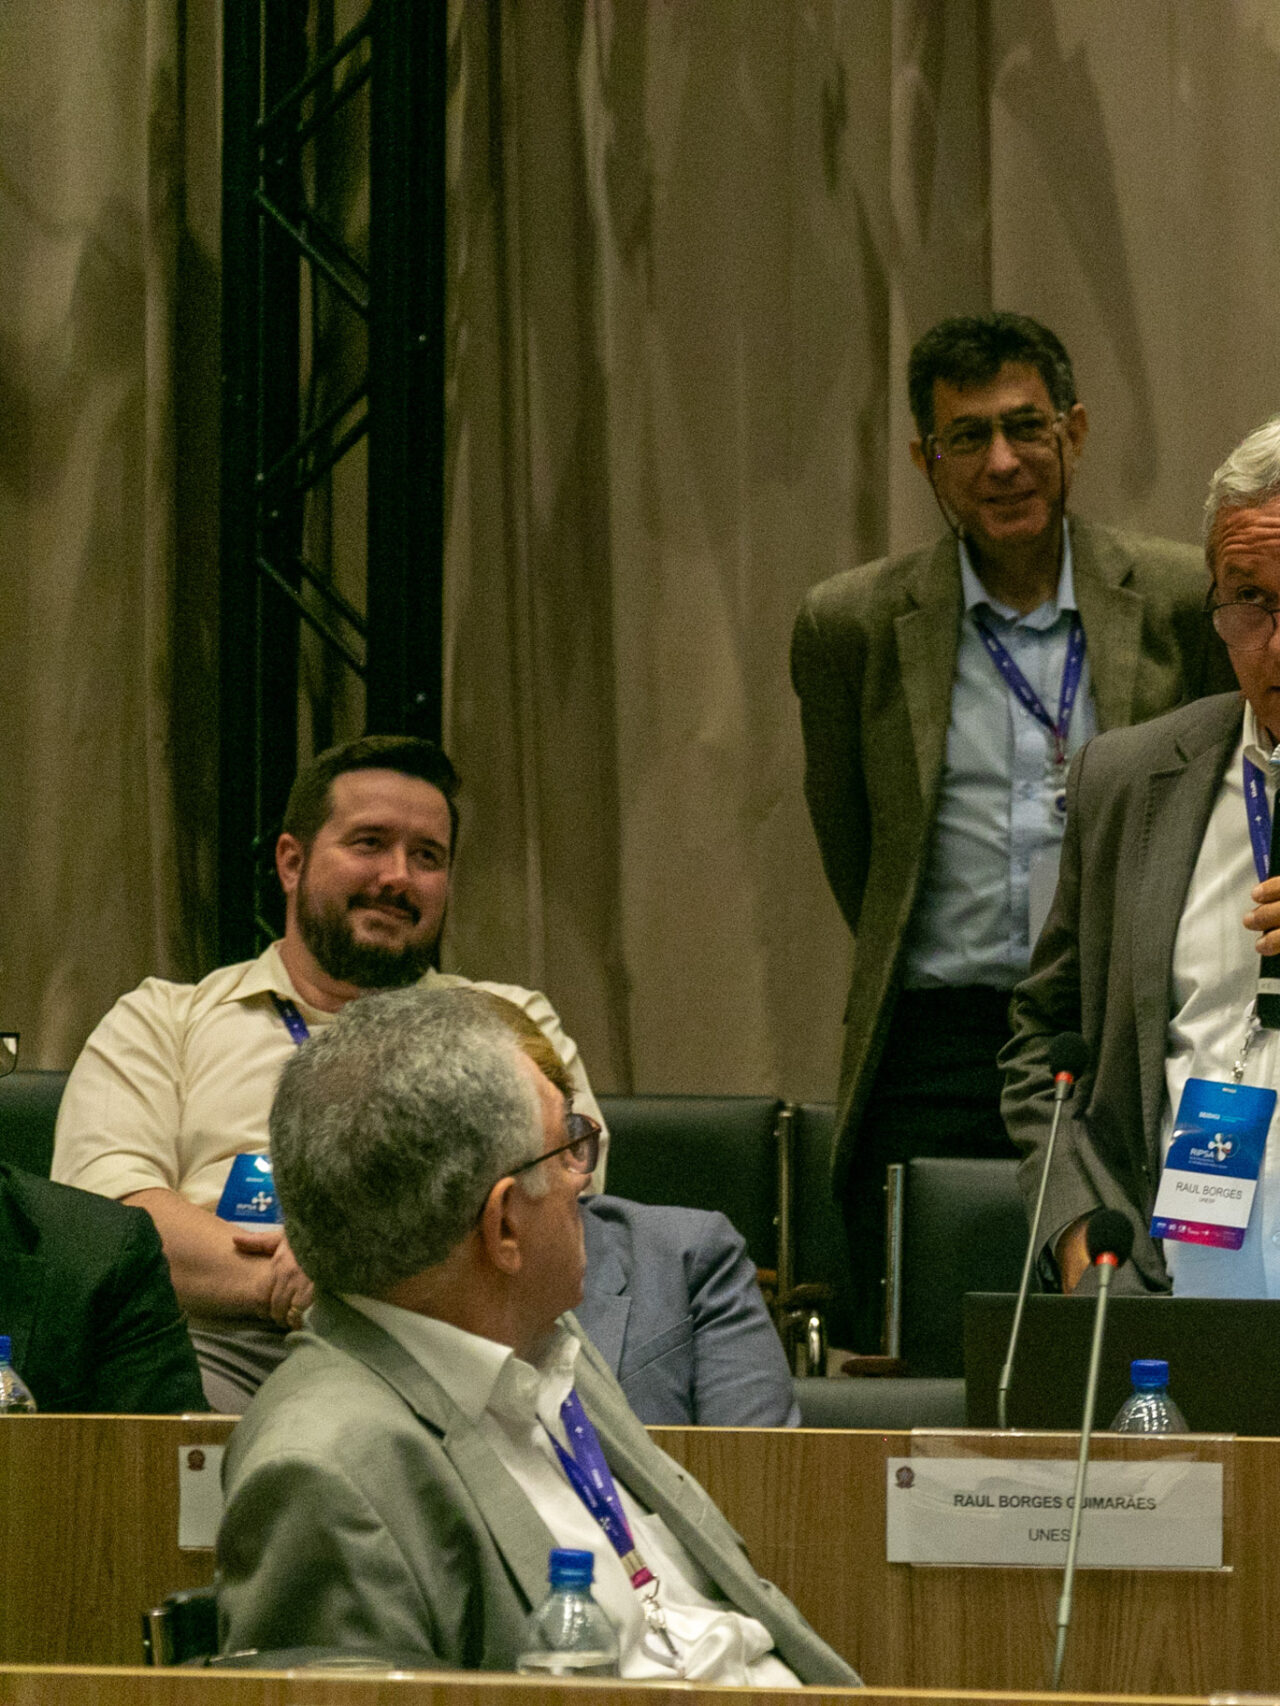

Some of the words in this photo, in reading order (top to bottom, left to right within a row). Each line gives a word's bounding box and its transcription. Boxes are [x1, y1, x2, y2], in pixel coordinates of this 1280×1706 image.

[1190, 1148, 1215, 1159] RIPSA
[1175, 1181, 1200, 1195] RAUL
[1202, 1185, 1243, 1200] BORGES
[953, 1494, 995, 1507] RAUL
[998, 1495, 1062, 1509] BORGES
[1028, 1528, 1081, 1542] UNES
